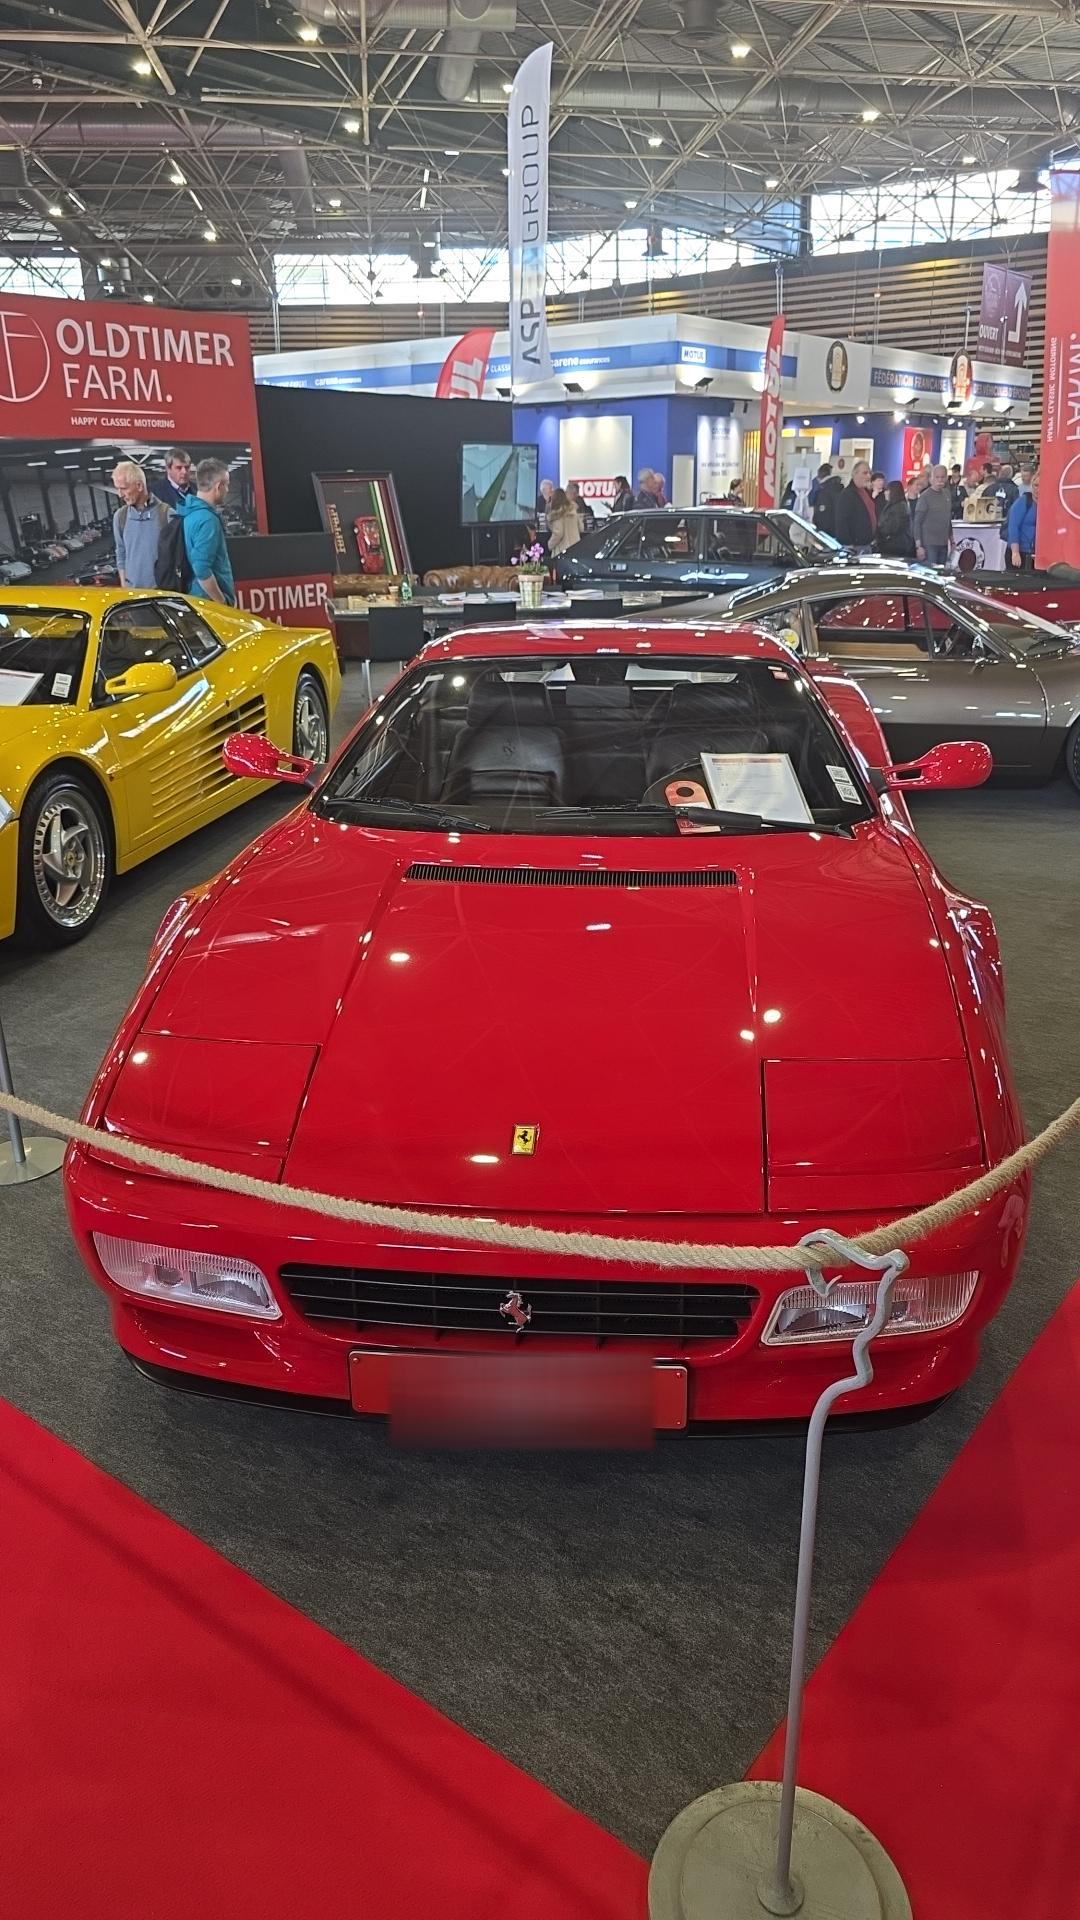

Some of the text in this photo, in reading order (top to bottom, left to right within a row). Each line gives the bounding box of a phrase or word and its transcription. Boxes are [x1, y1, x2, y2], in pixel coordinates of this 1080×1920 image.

[521, 104, 541, 365] ASP GROUP
[56, 318, 234, 367] OLDTIMER
[979, 324, 999, 341] OUVERT
[490, 364, 511, 373] CLASSI
[684, 349, 704, 361] MOTUL
[62, 362, 173, 403] FARM.
[71, 416, 176, 429] HAPPY CLASSIC MOTORING
[763, 344, 781, 498] MOTUL
[234, 582, 328, 614] LDTIMER
